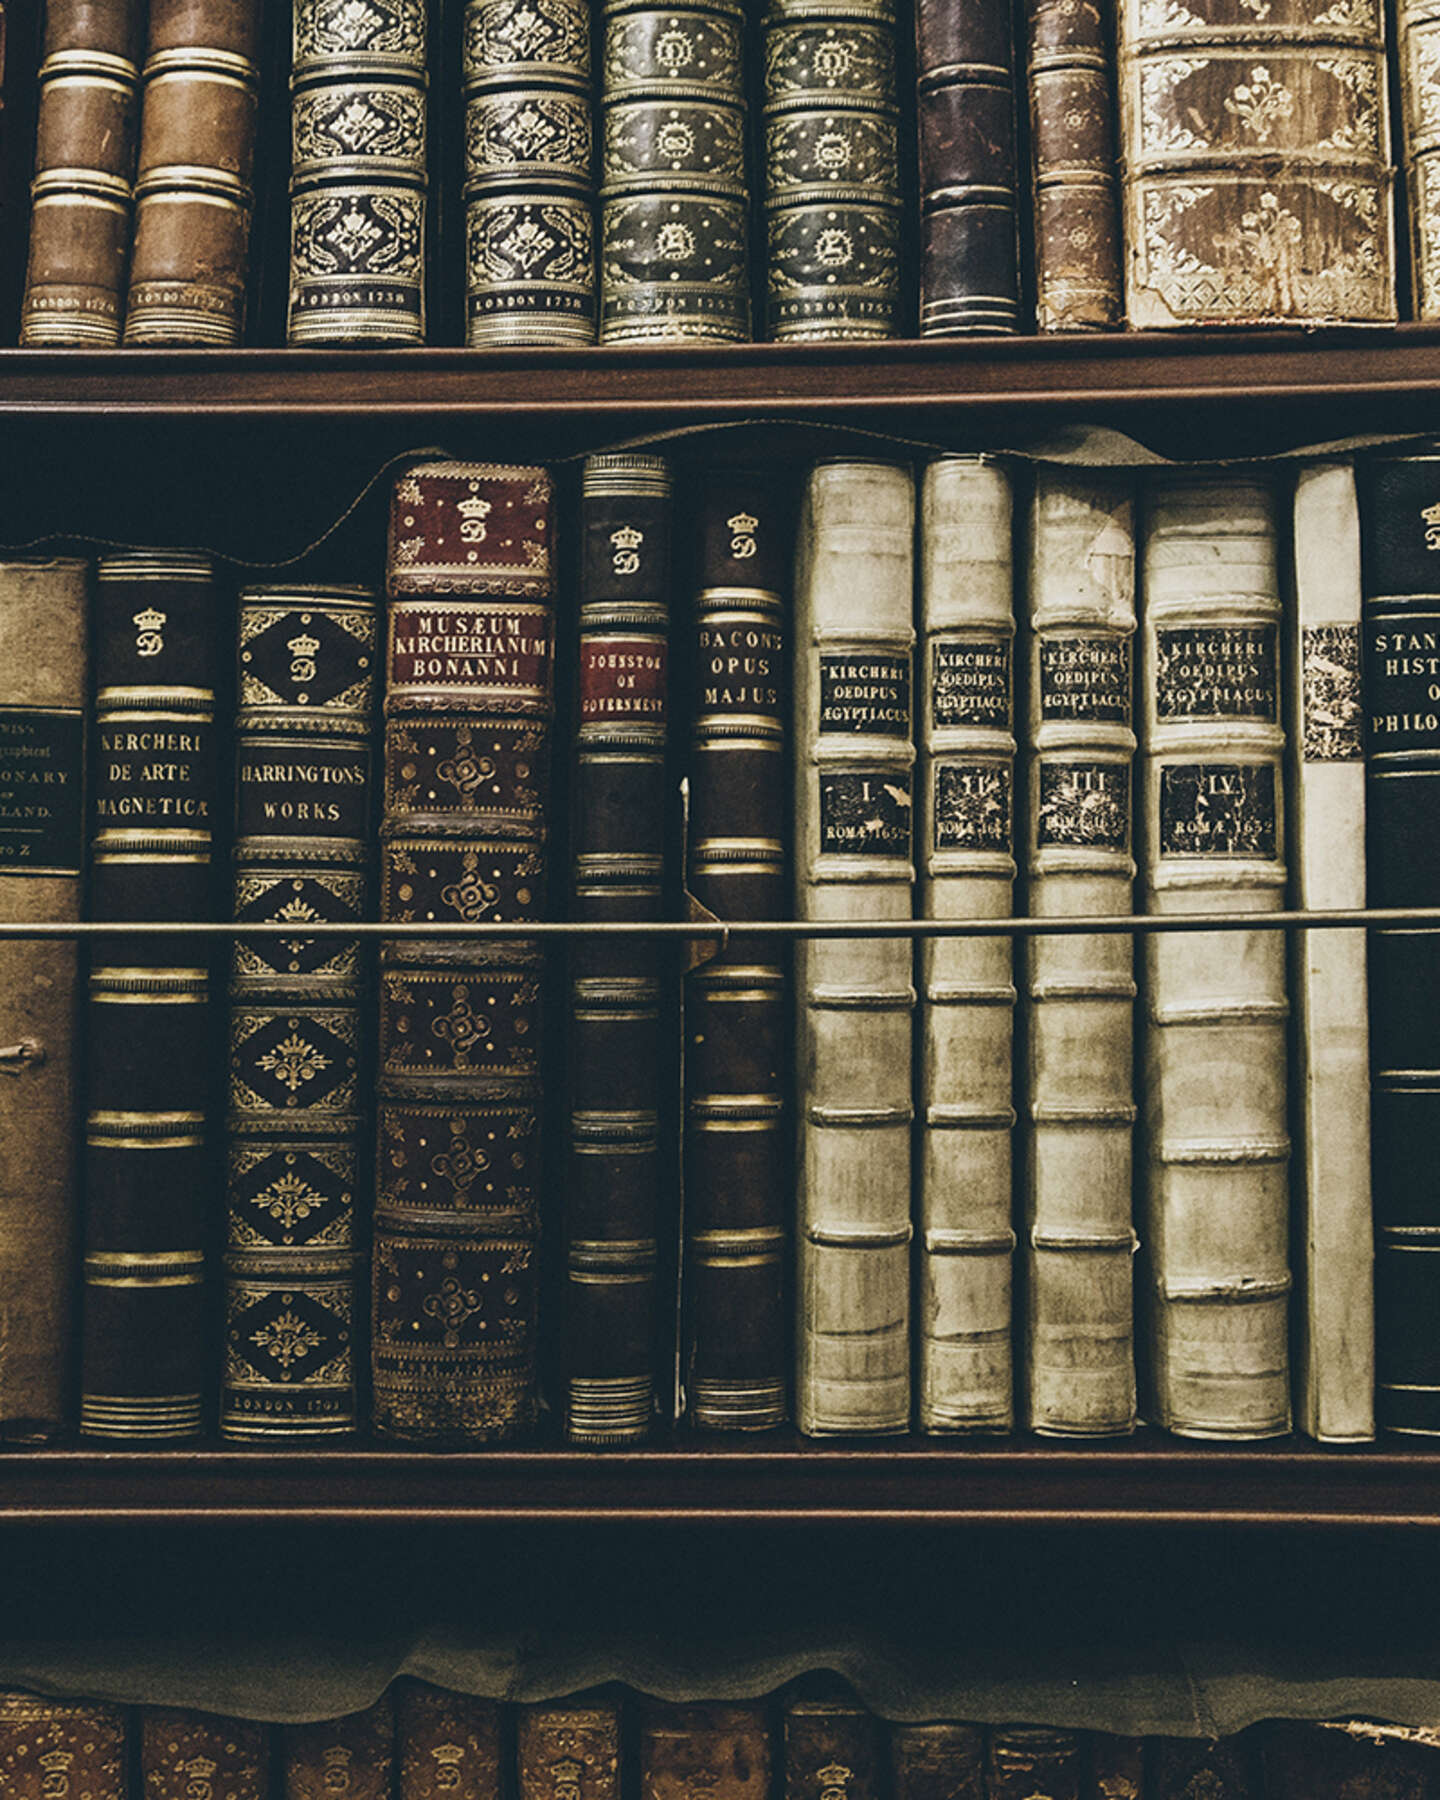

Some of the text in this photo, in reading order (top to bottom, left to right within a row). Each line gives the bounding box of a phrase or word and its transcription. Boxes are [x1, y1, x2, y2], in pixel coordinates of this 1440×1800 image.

[32, 298, 80, 309] LONDON
[300, 291, 361, 307] LONDON
[476, 295, 535, 311] LONDON
[617, 296, 687, 311] LONDON
[780, 300, 848, 316] LONDON
[395, 635, 546, 657] KIRCHERIANUM
[413, 658, 519, 678] BONANNI
[711, 656, 771, 676] OPUS
[829, 664, 905, 681] KIRCHERI
[617, 674, 635, 689] ON
[705, 686, 777, 705] MAJUS
[834, 684, 898, 701] OEDIPUS
[109, 763, 191, 782] DE ARTE
[96, 797, 209, 817] MAGNETICA
[263, 800, 341, 822] WORKS
[20, 843, 31, 857] Z
[233, 1395, 294, 1412] LONDON
